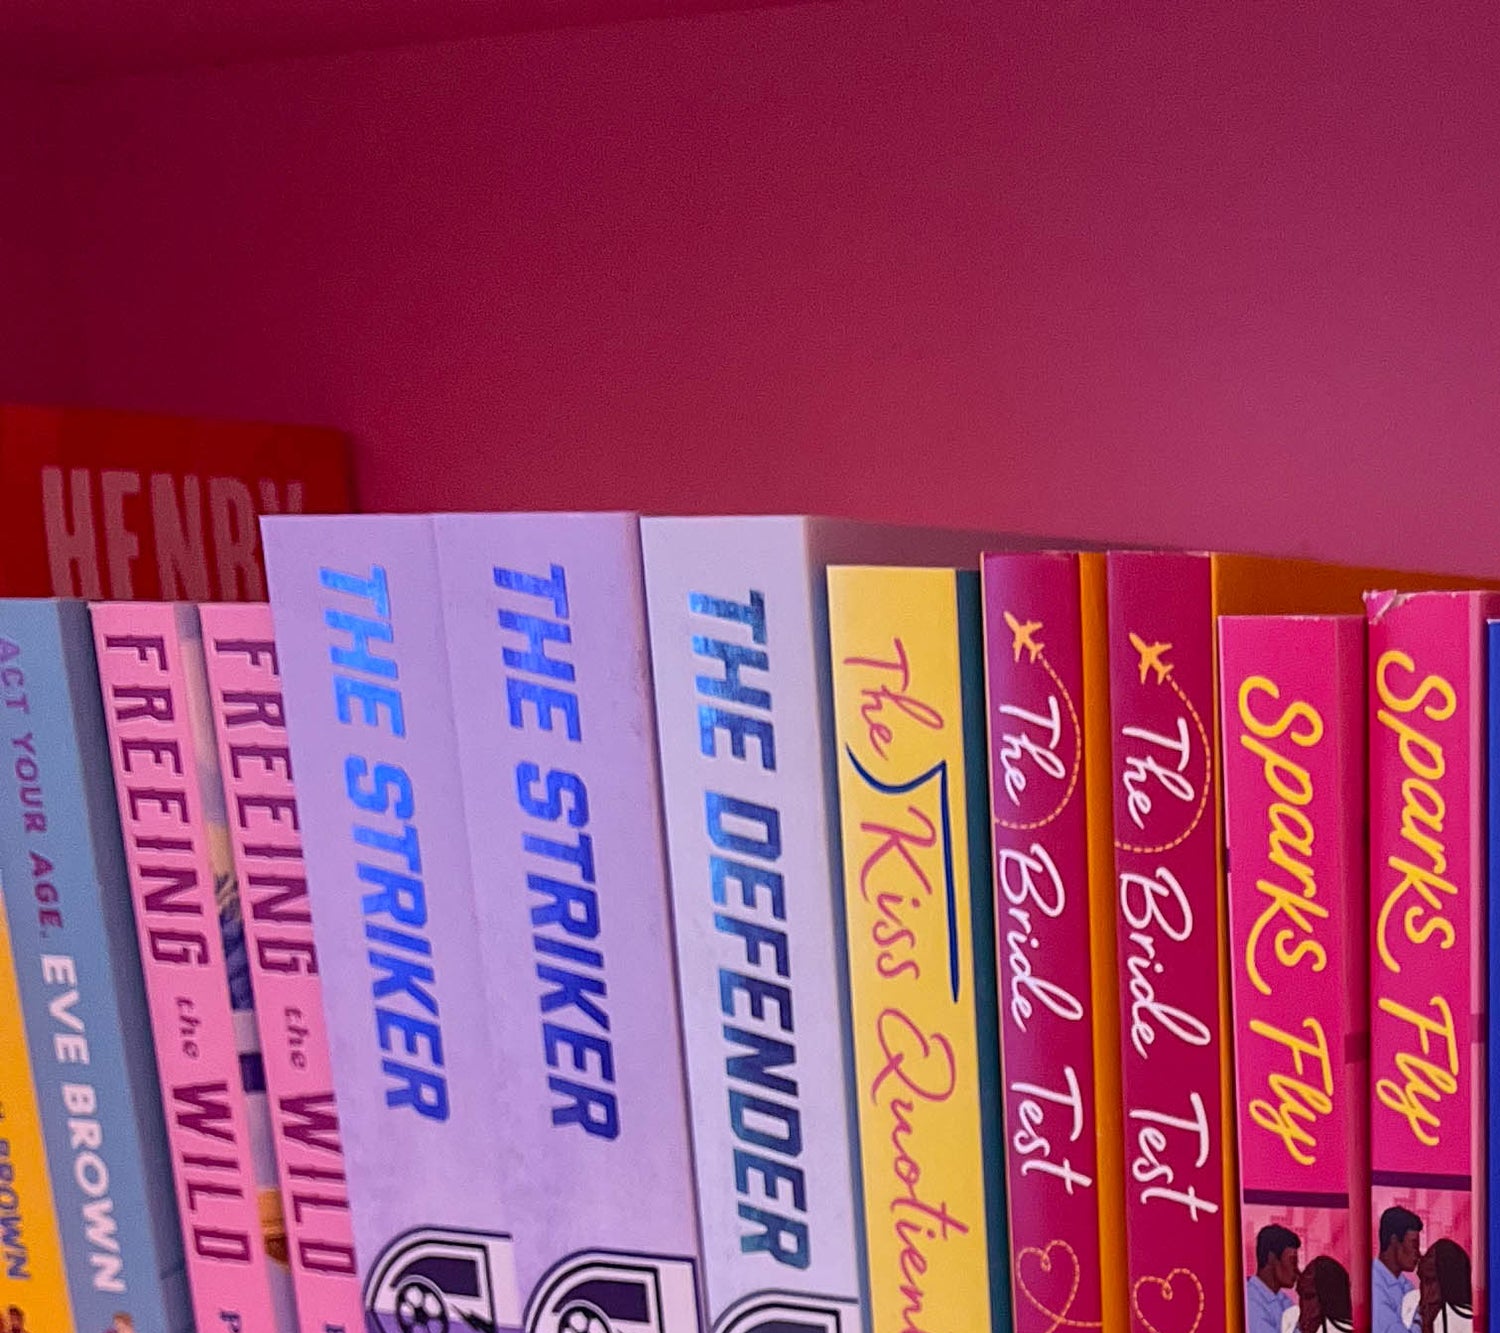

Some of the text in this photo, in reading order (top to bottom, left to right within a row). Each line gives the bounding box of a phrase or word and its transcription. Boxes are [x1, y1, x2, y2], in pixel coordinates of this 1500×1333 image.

[104, 634, 210, 968] FREEING
[214, 637, 319, 974] FREEING
[318, 565, 451, 1124] THE STRIKER
[492, 563, 621, 1143] THE STRIKER
[843, 636, 945, 762] The
[859, 805, 938, 981] Kiss
[1376, 650, 1459, 1147] Sparks Fly
[8, 738, 126, 1293] YOUR EVE BROWN
[174, 996, 202, 1062] the
[284, 1005, 309, 1072] the
[689, 588, 812, 1271] THE DEFENDER
[999, 695, 1093, 1196] The Bride Test
[1119, 716, 1220, 1223] The Bride Test
[1238, 674, 1334, 1167] Sparks Fly
[173, 1081, 252, 1264] WILD
[279, 1093, 358, 1277] WILD
